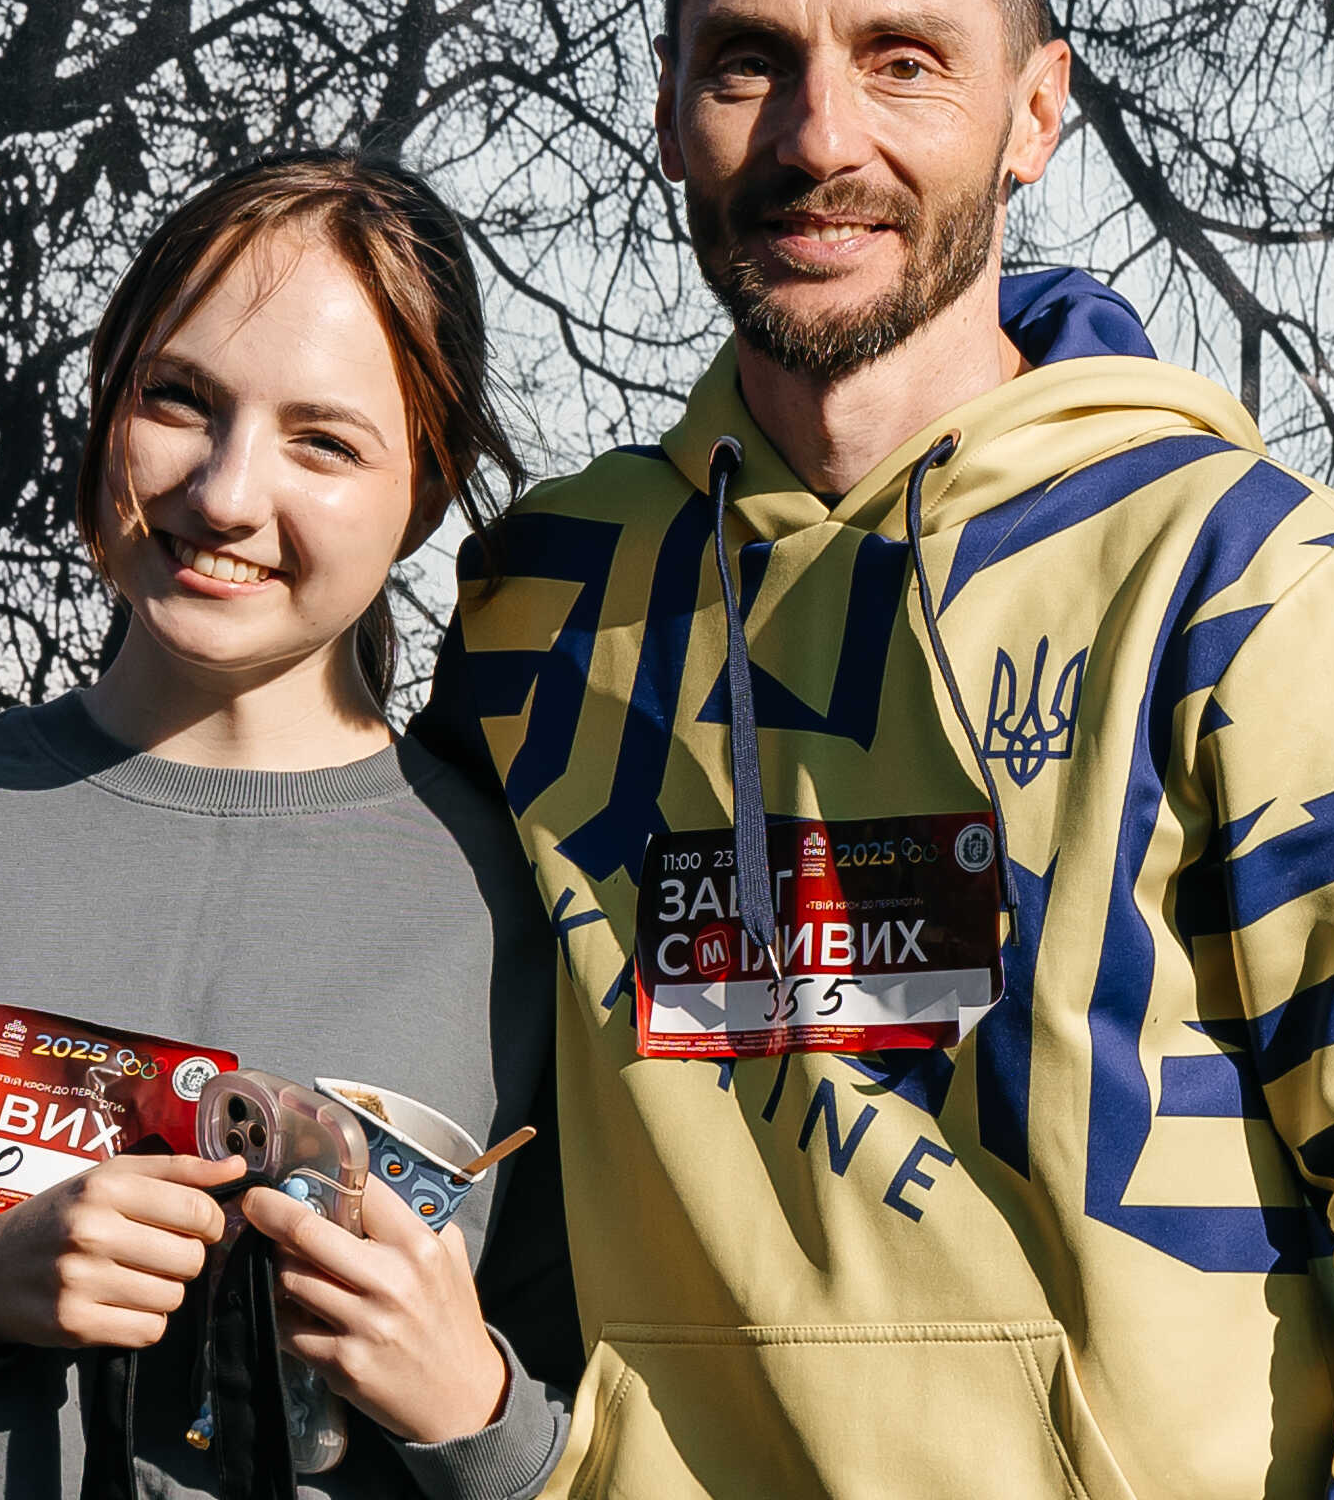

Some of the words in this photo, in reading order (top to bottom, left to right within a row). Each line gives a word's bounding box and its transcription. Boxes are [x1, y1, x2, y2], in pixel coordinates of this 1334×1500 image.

[662, 851, 702, 872] 11:00
[836, 841, 895, 868] 2025
[764, 977, 862, 1022] 355
[32, 1033, 110, 1064] 2025
[22, 1080, 51, 1094] КРОК
[52, 1084, 70, 1096] ДО
